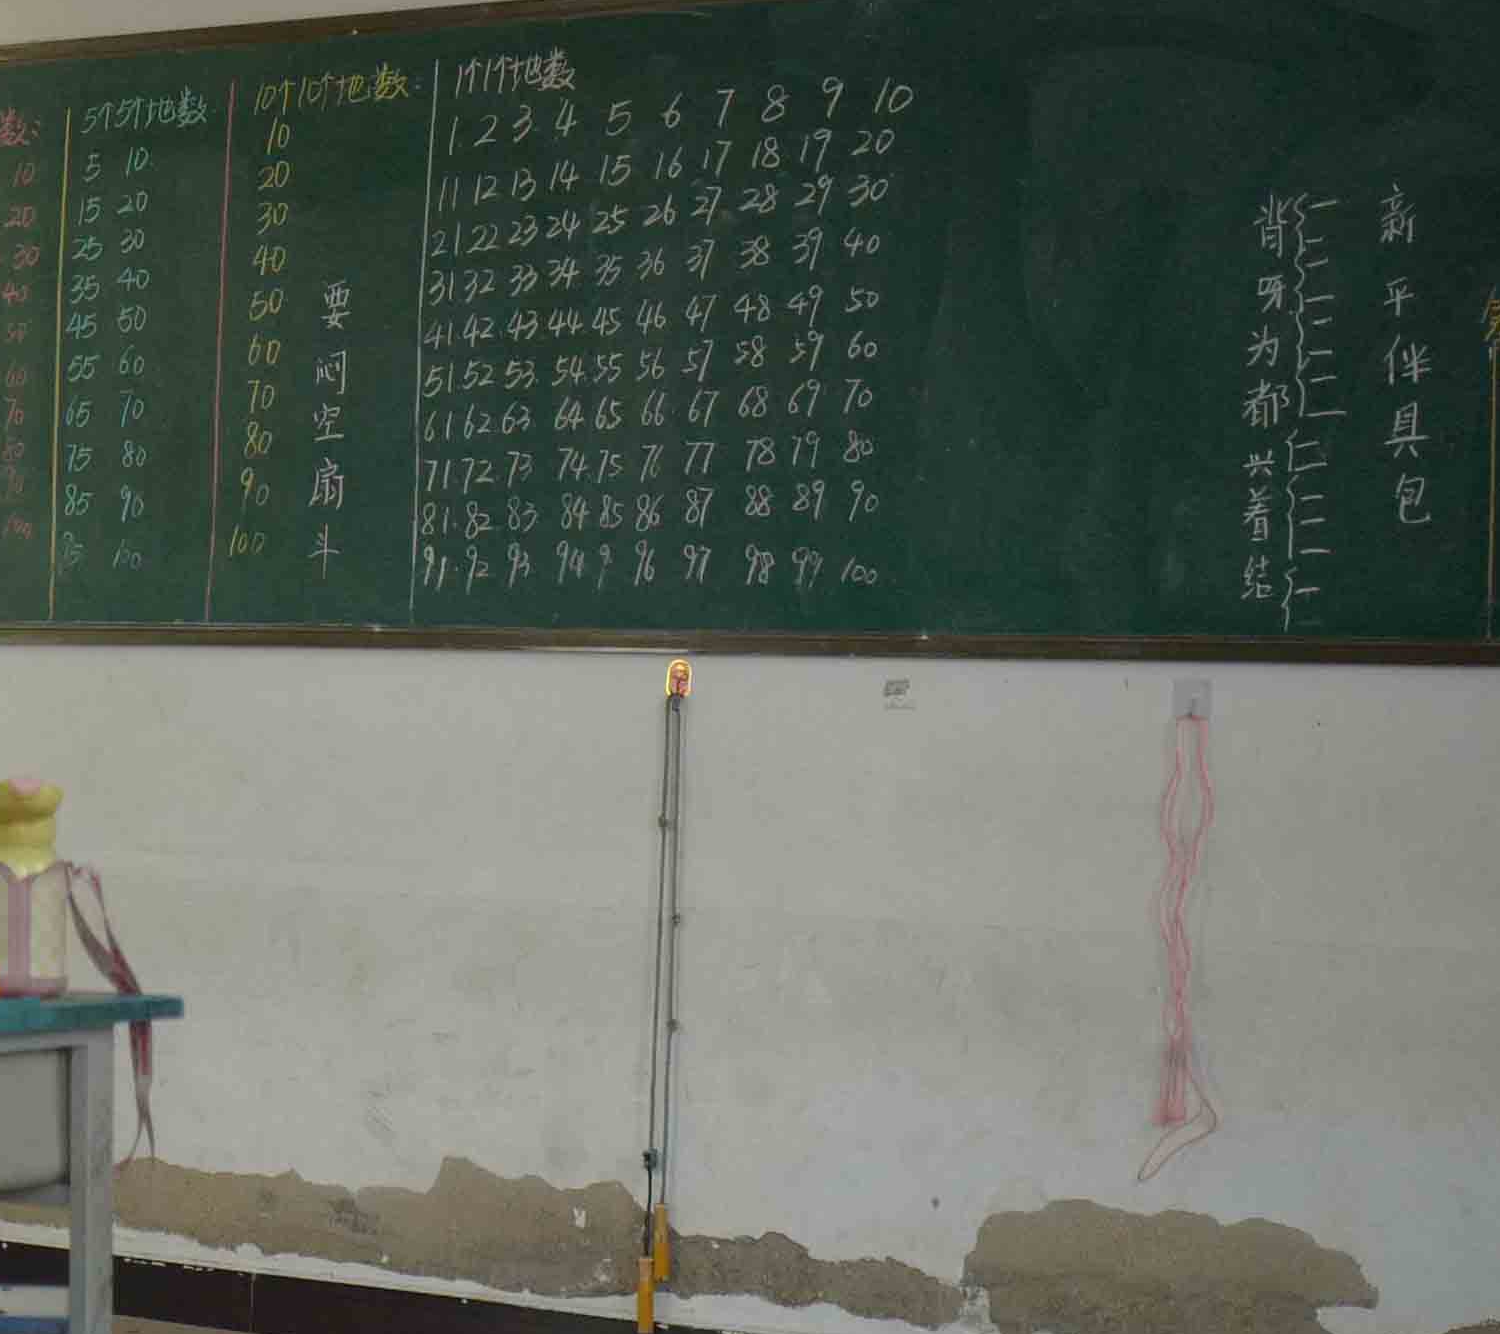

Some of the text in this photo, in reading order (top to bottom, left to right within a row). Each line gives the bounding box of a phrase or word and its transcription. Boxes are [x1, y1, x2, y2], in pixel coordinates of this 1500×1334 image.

[473, 114, 499, 147] 2
[512, 103, 533, 144] 3
[555, 99, 579, 137] 4
[605, 99, 632, 137] 5
[660, 92, 683, 129] 6
[716, 88, 736, 128] 7
[761, 84, 790, 123] 8
[821, 76, 844, 119] 9
[873, 77, 914, 114] 10
[266, 118, 290, 154] 10
[82, 146, 152, 183] 5 10
[258, 161, 293, 191] 20
[438, 127, 895, 214] 11 12 13 14 15 16 17 18 19 20
[78, 190, 148, 227] 15 20
[257, 201, 289, 230] 30
[430, 173, 889, 257] 21 22 23 24 25 26 27 28 29 30
[72, 228, 145, 261] 25 30
[252, 243, 288, 276] 40
[428, 226, 881, 307] 31 32 33 34 35 36 37 38 39 40
[69, 267, 150, 305] 35 40
[248, 287, 287, 321] 50
[65, 303, 147, 340] 45 50
[423, 284, 880, 350] 41 42 43 44 45 46 47 48 49 50
[67, 348, 145, 383] 55 60
[247, 335, 282, 366] 60
[424, 329, 878, 398] 51 52 53 54 55 56 57 58 59 60
[65, 389, 145, 428] 65 70
[247, 379, 277, 414] 70
[424, 378, 874, 442] 61 62 63 64 65 66 67 68 69 70
[65, 439, 147, 473] 75 80
[244, 422, 273, 459] 80
[424, 459, 451, 492] 71
[461, 457, 494, 495] 72
[557, 446, 588, 481] 74
[595, 449, 624, 484] 75
[684, 440, 717, 475] 77
[746, 436, 776, 472] 78
[791, 430, 820, 469] 79
[842, 429, 874, 463] 80
[64, 482, 145, 523] 85 90
[240, 467, 270, 511] 90
[420, 479, 880, 540] 81 82 83 84 85 86 87 88 89 90
[228, 524, 267, 557] 100
[466, 544, 490, 595] 92
[633, 539, 655, 587] 96
[683, 544, 712, 584] 97
[840, 557, 878, 584] 100
